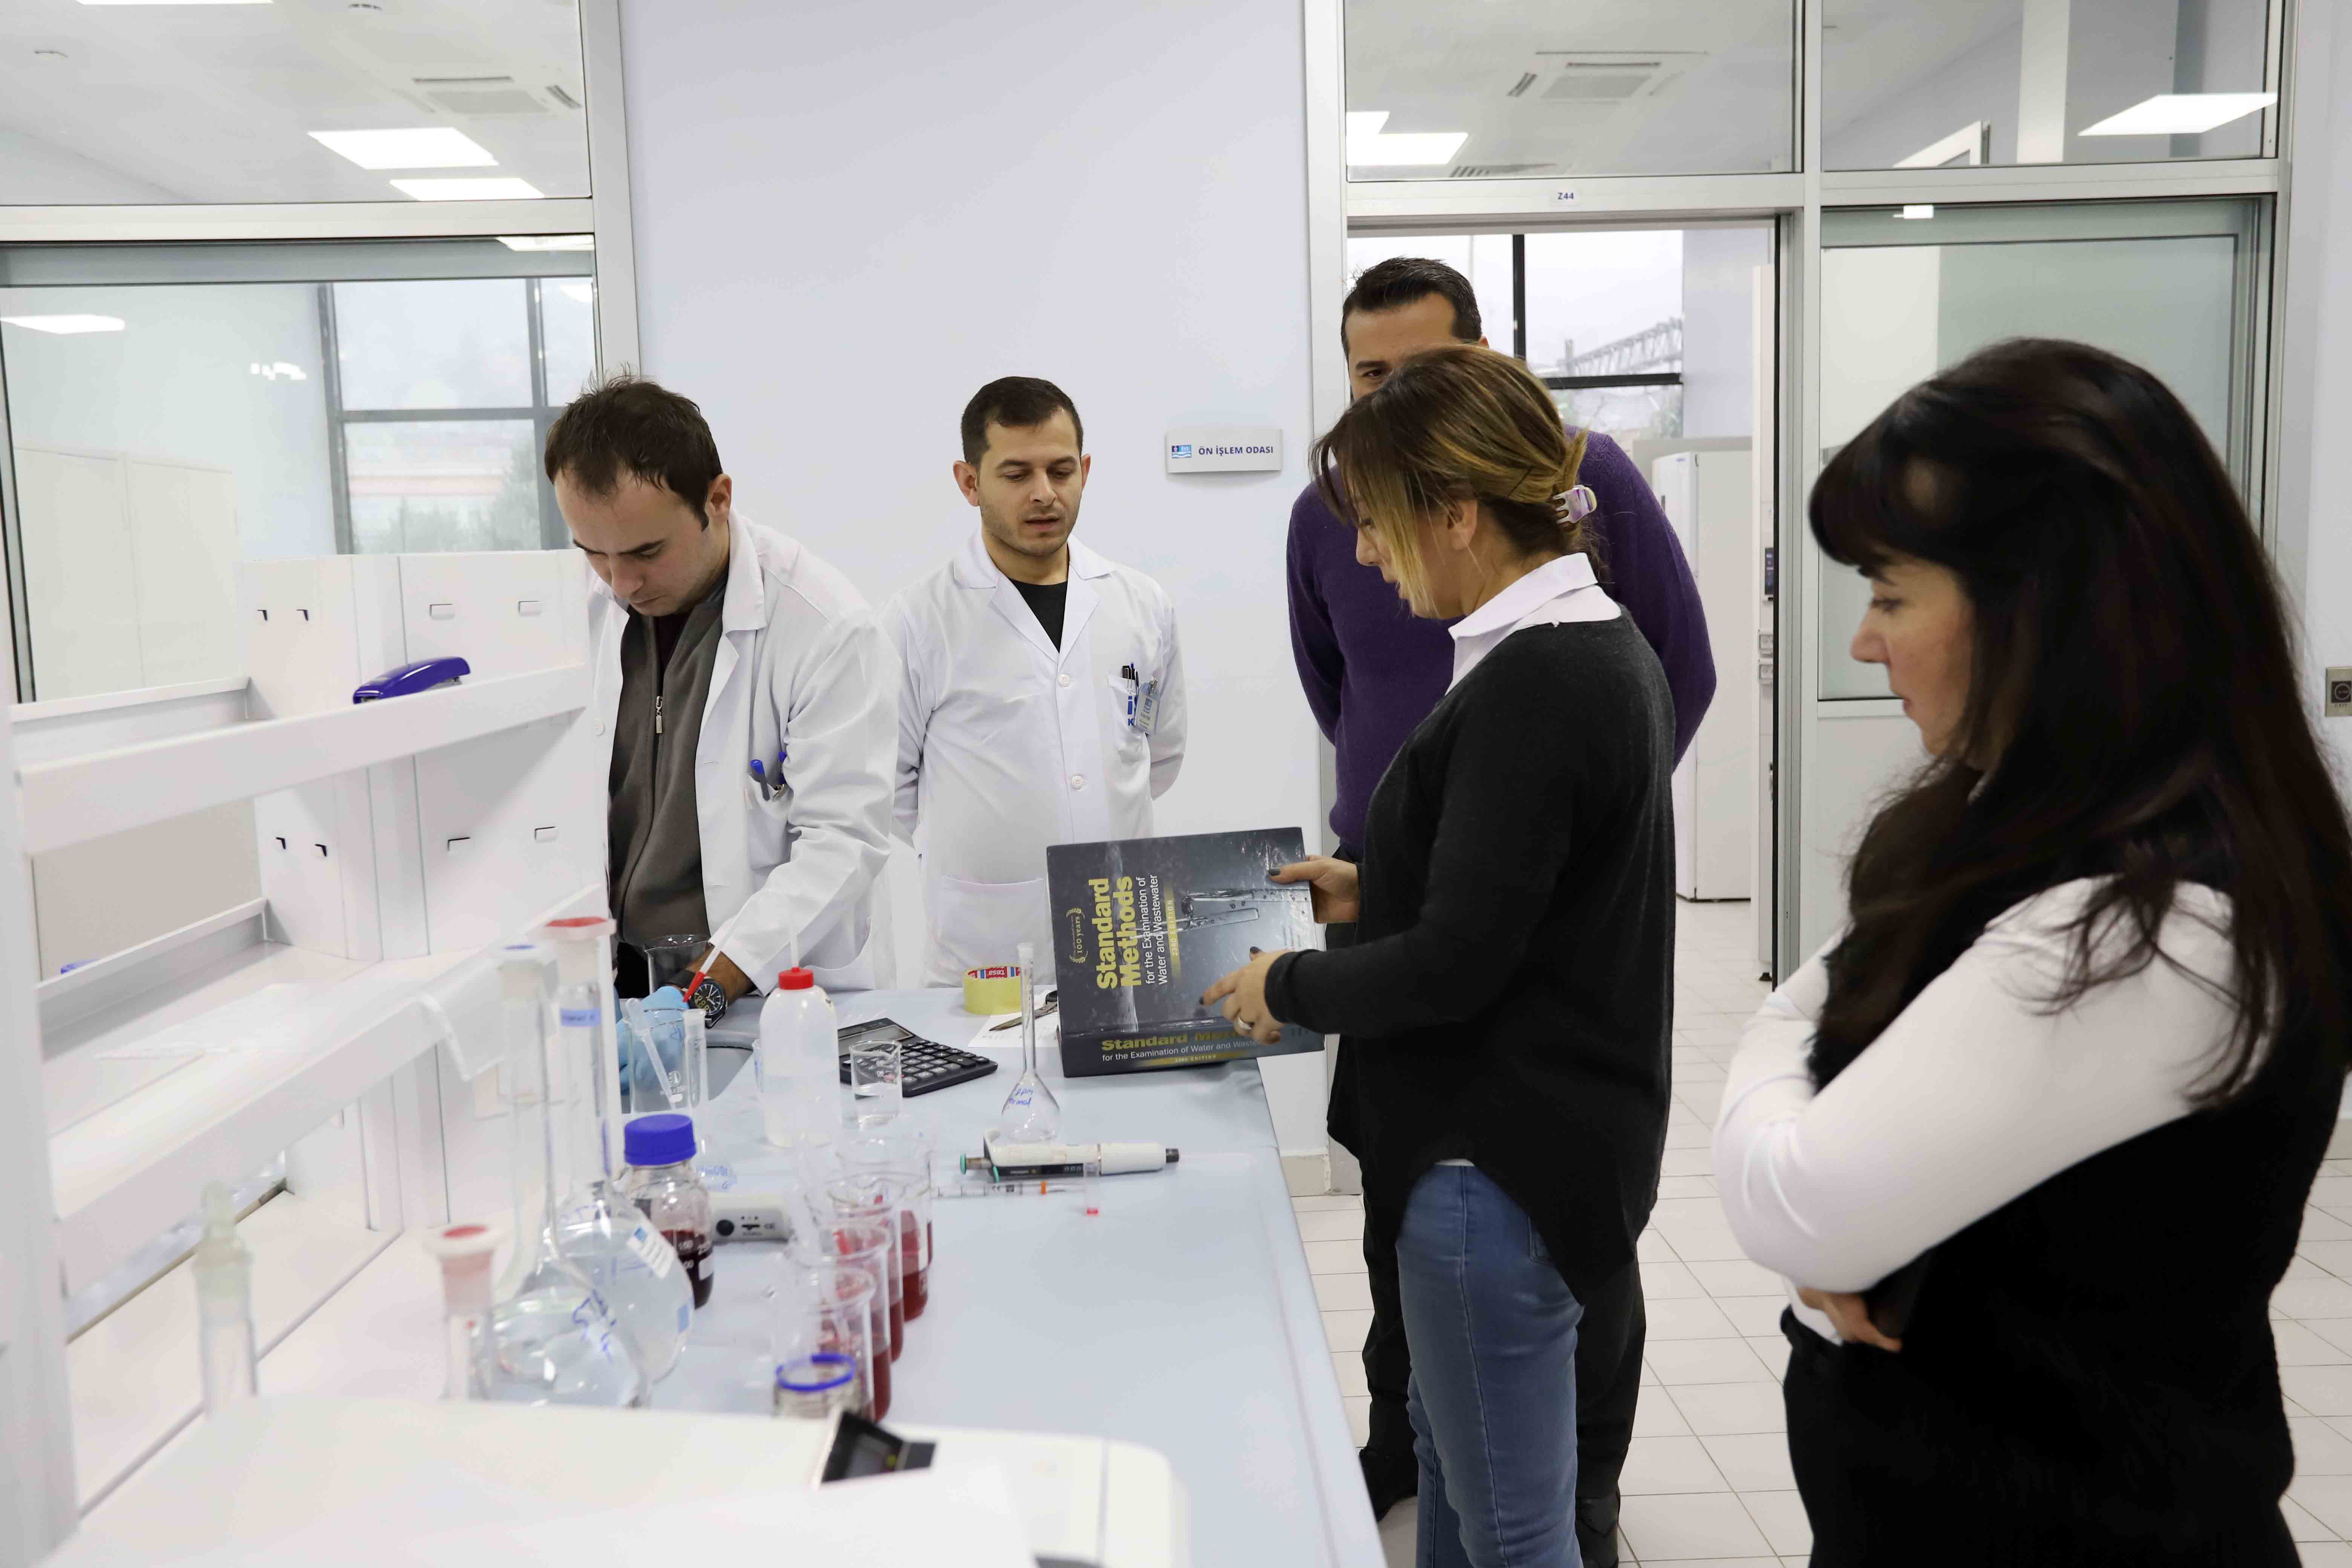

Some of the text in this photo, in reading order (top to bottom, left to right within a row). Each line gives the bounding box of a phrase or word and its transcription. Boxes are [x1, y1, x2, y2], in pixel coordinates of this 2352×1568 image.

[1198, 446, 1213, 455] ÖN
[1216, 446, 1243, 456] İŞLEM
[1075, 916, 1084, 937] years
[1088, 878, 1118, 989] Standard
[1113, 876, 1142, 987] Methods
[1136, 876, 1155, 985] for the Examination of
[1150, 874, 1168, 985] Water and Wastewater
[1167, 899, 1176, 935] EDITION
[1101, 1034, 1188, 1051] Standard
[1131, 1048, 1178, 1058] Examination
[1191, 1043, 1214, 1053] Water
[1216, 1040, 1231, 1050] and
